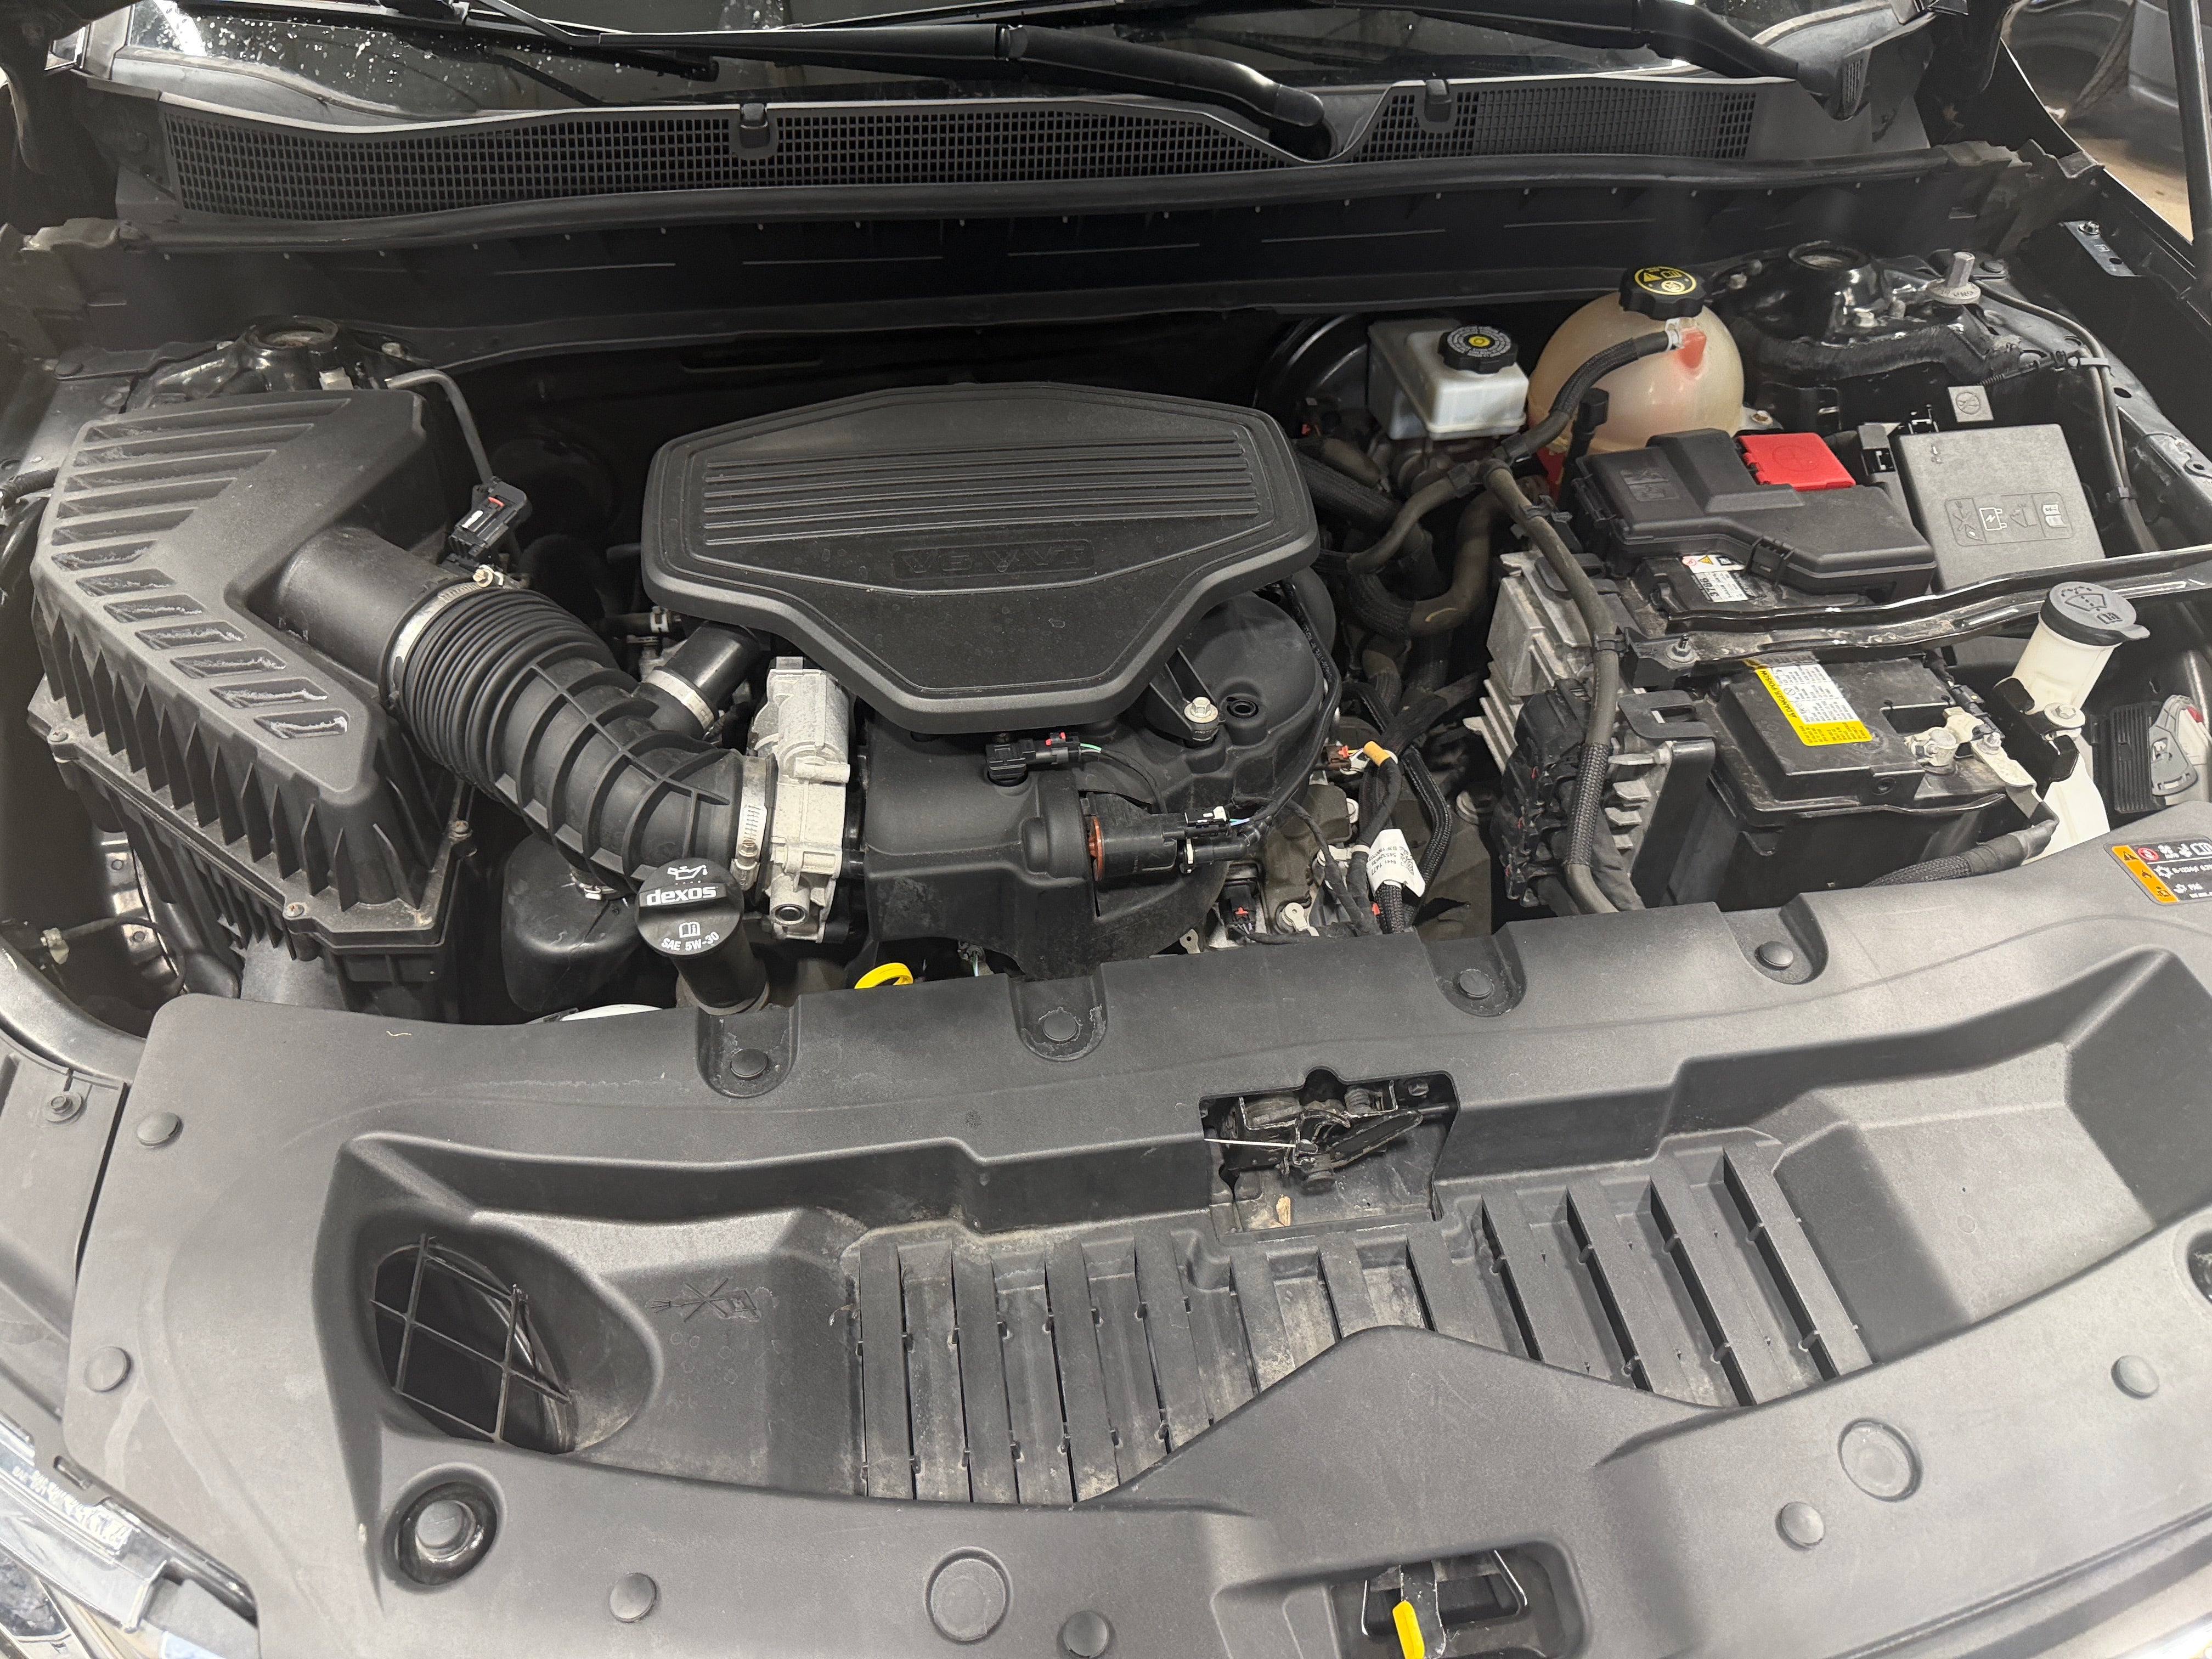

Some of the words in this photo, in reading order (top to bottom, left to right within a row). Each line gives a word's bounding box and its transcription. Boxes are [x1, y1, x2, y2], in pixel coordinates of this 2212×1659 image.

[646, 886, 716, 906] dexos
[661, 938, 681, 951] SAE
[685, 931, 720, 951] 5W-30
